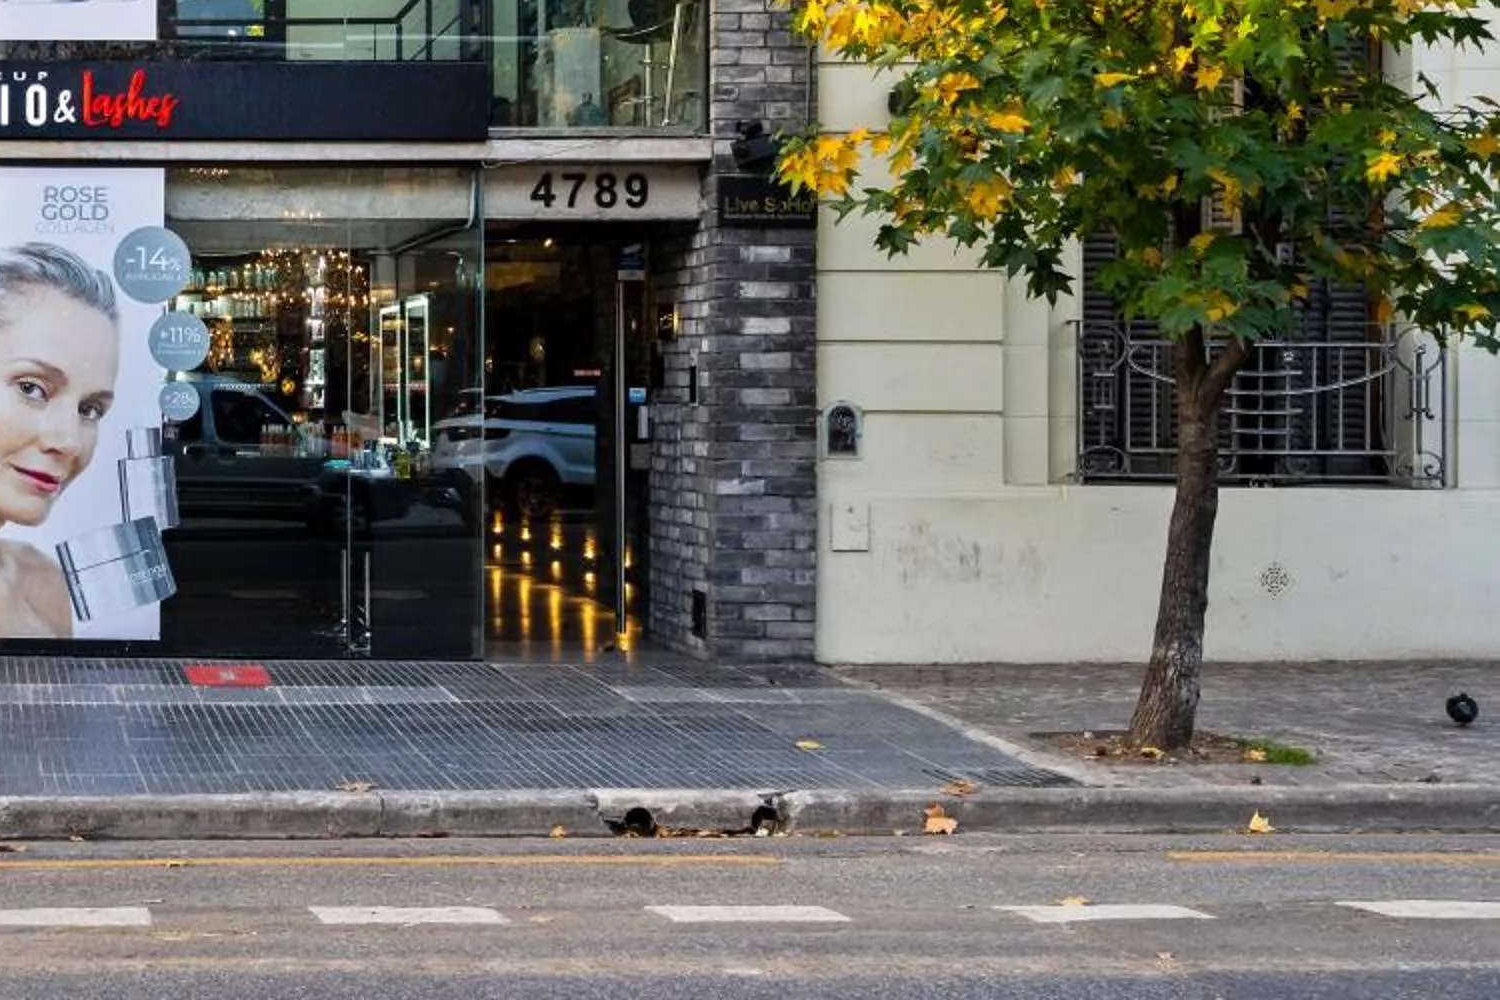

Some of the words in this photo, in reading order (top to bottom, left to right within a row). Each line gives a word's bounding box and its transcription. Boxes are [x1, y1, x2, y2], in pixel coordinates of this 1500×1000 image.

[43, 185, 109, 203] ROSE
[530, 172, 649, 209] 4789
[41, 203, 110, 221] GOLD
